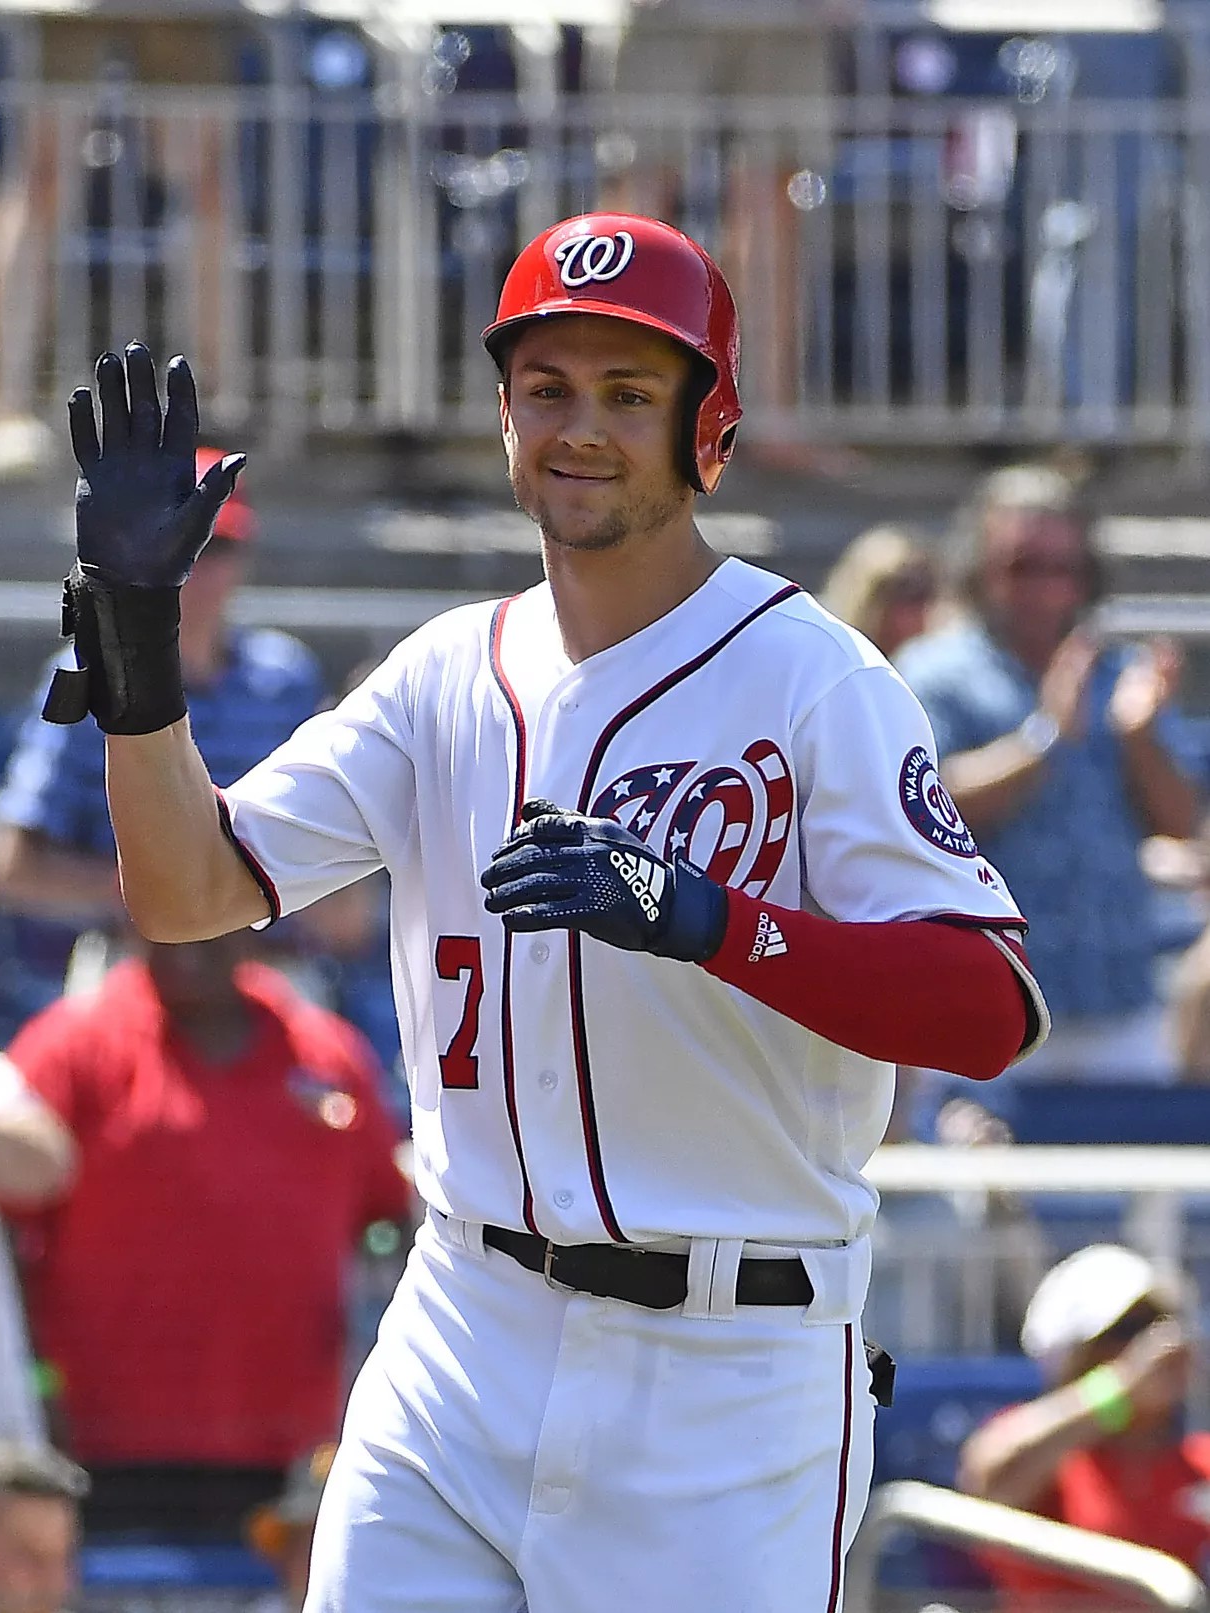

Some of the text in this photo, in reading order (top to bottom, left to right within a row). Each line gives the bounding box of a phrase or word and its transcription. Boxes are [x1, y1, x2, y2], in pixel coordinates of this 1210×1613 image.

[553, 230, 635, 288] W
[905, 750, 932, 802] WASHIN
[931, 827, 976, 852] NATIO
[608, 850, 660, 923] adidas
[747, 911, 770, 963] adidas
[435, 935, 485, 1090] 7
